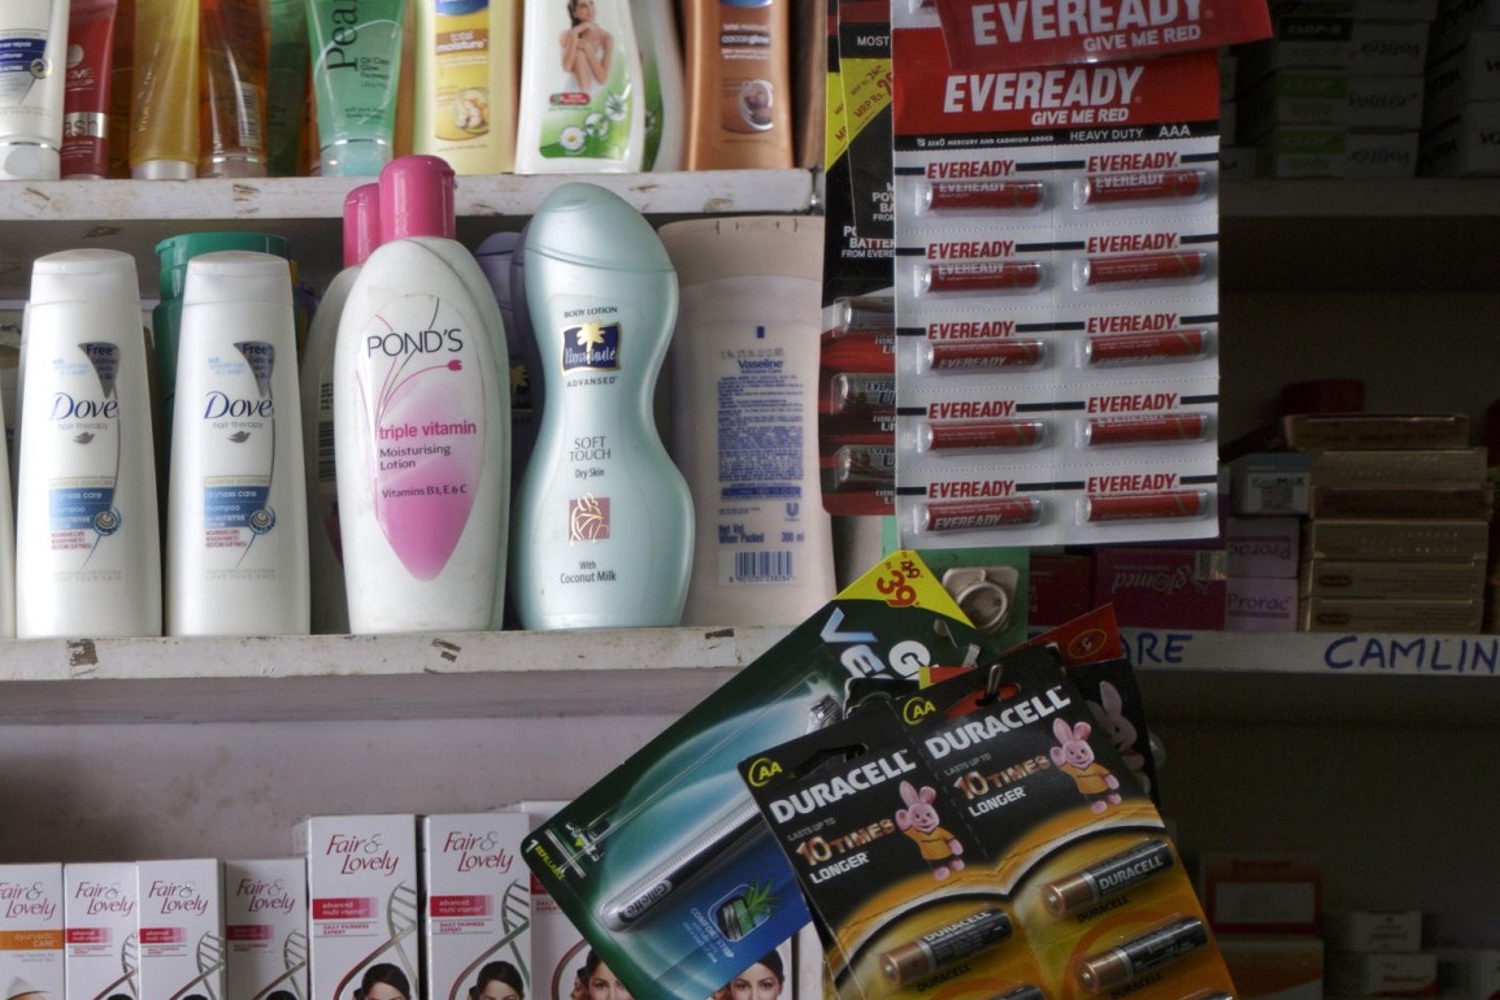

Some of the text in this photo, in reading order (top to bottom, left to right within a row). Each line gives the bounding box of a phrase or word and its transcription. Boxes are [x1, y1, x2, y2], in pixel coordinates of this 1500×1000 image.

[971, 0, 1202, 46] EVEREADY
[1083, 25, 1202, 52] GIVE ME RED
[943, 66, 1145, 113] EVEREADY
[1031, 107, 1130, 126] GIVE ME RED
[1069, 124, 1191, 142] HEAVY DUTY AAA
[927, 160, 1014, 180] EVEREADY
[1087, 151, 1178, 173] EVEREADY
[927, 240, 1014, 260] EVEREADY
[1087, 233, 1178, 254] EVEREADY
[563, 305, 619, 319] BODY LOTION
[928, 320, 1014, 340] EVEREADY
[1086, 313, 1178, 334] EVEREADY
[367, 328, 464, 359] POND'S
[50, 391, 119, 421] Dove
[203, 390, 273, 420] Dove
[928, 400, 1015, 420] EVEREADY
[1086, 393, 1178, 414] EVEREADY
[379, 420, 477, 442] triple vitamin
[379, 444, 452, 459] Moisturising
[573, 435, 607, 450] SOFT
[379, 458, 417, 472] Lotion
[569, 448, 612, 463] TOUCH
[574, 466, 605, 480] Dry Skin
[1086, 473, 1178, 494] EVEREADY
[928, 480, 1014, 499] EVEREADY
[579, 560, 598, 571] With
[560, 570, 618, 584] Coconut Milk
[924, 685, 1071, 761] DURACELL
[769, 748, 917, 825] DURACELL
[954, 754, 1052, 801] 10 TIMES
[967, 785, 1028, 818] LONGER
[325, 834, 364, 856] Fair
[443, 831, 482, 853] Fair
[796, 816, 897, 867] 10 TIMES
[340, 850, 400, 876] Lovely
[456, 849, 514, 874] Lovely
[808, 851, 871, 885] LONGER
[1098, 854, 1165, 892] DURACELL
[75, 880, 106, 900] Fair
[148, 880, 179, 900] Fair
[235, 878, 269, 899] Fair
[5, 899, 58, 921] Lovely
[87, 897, 134, 917] Lovely
[160, 897, 210, 917] Lovely
